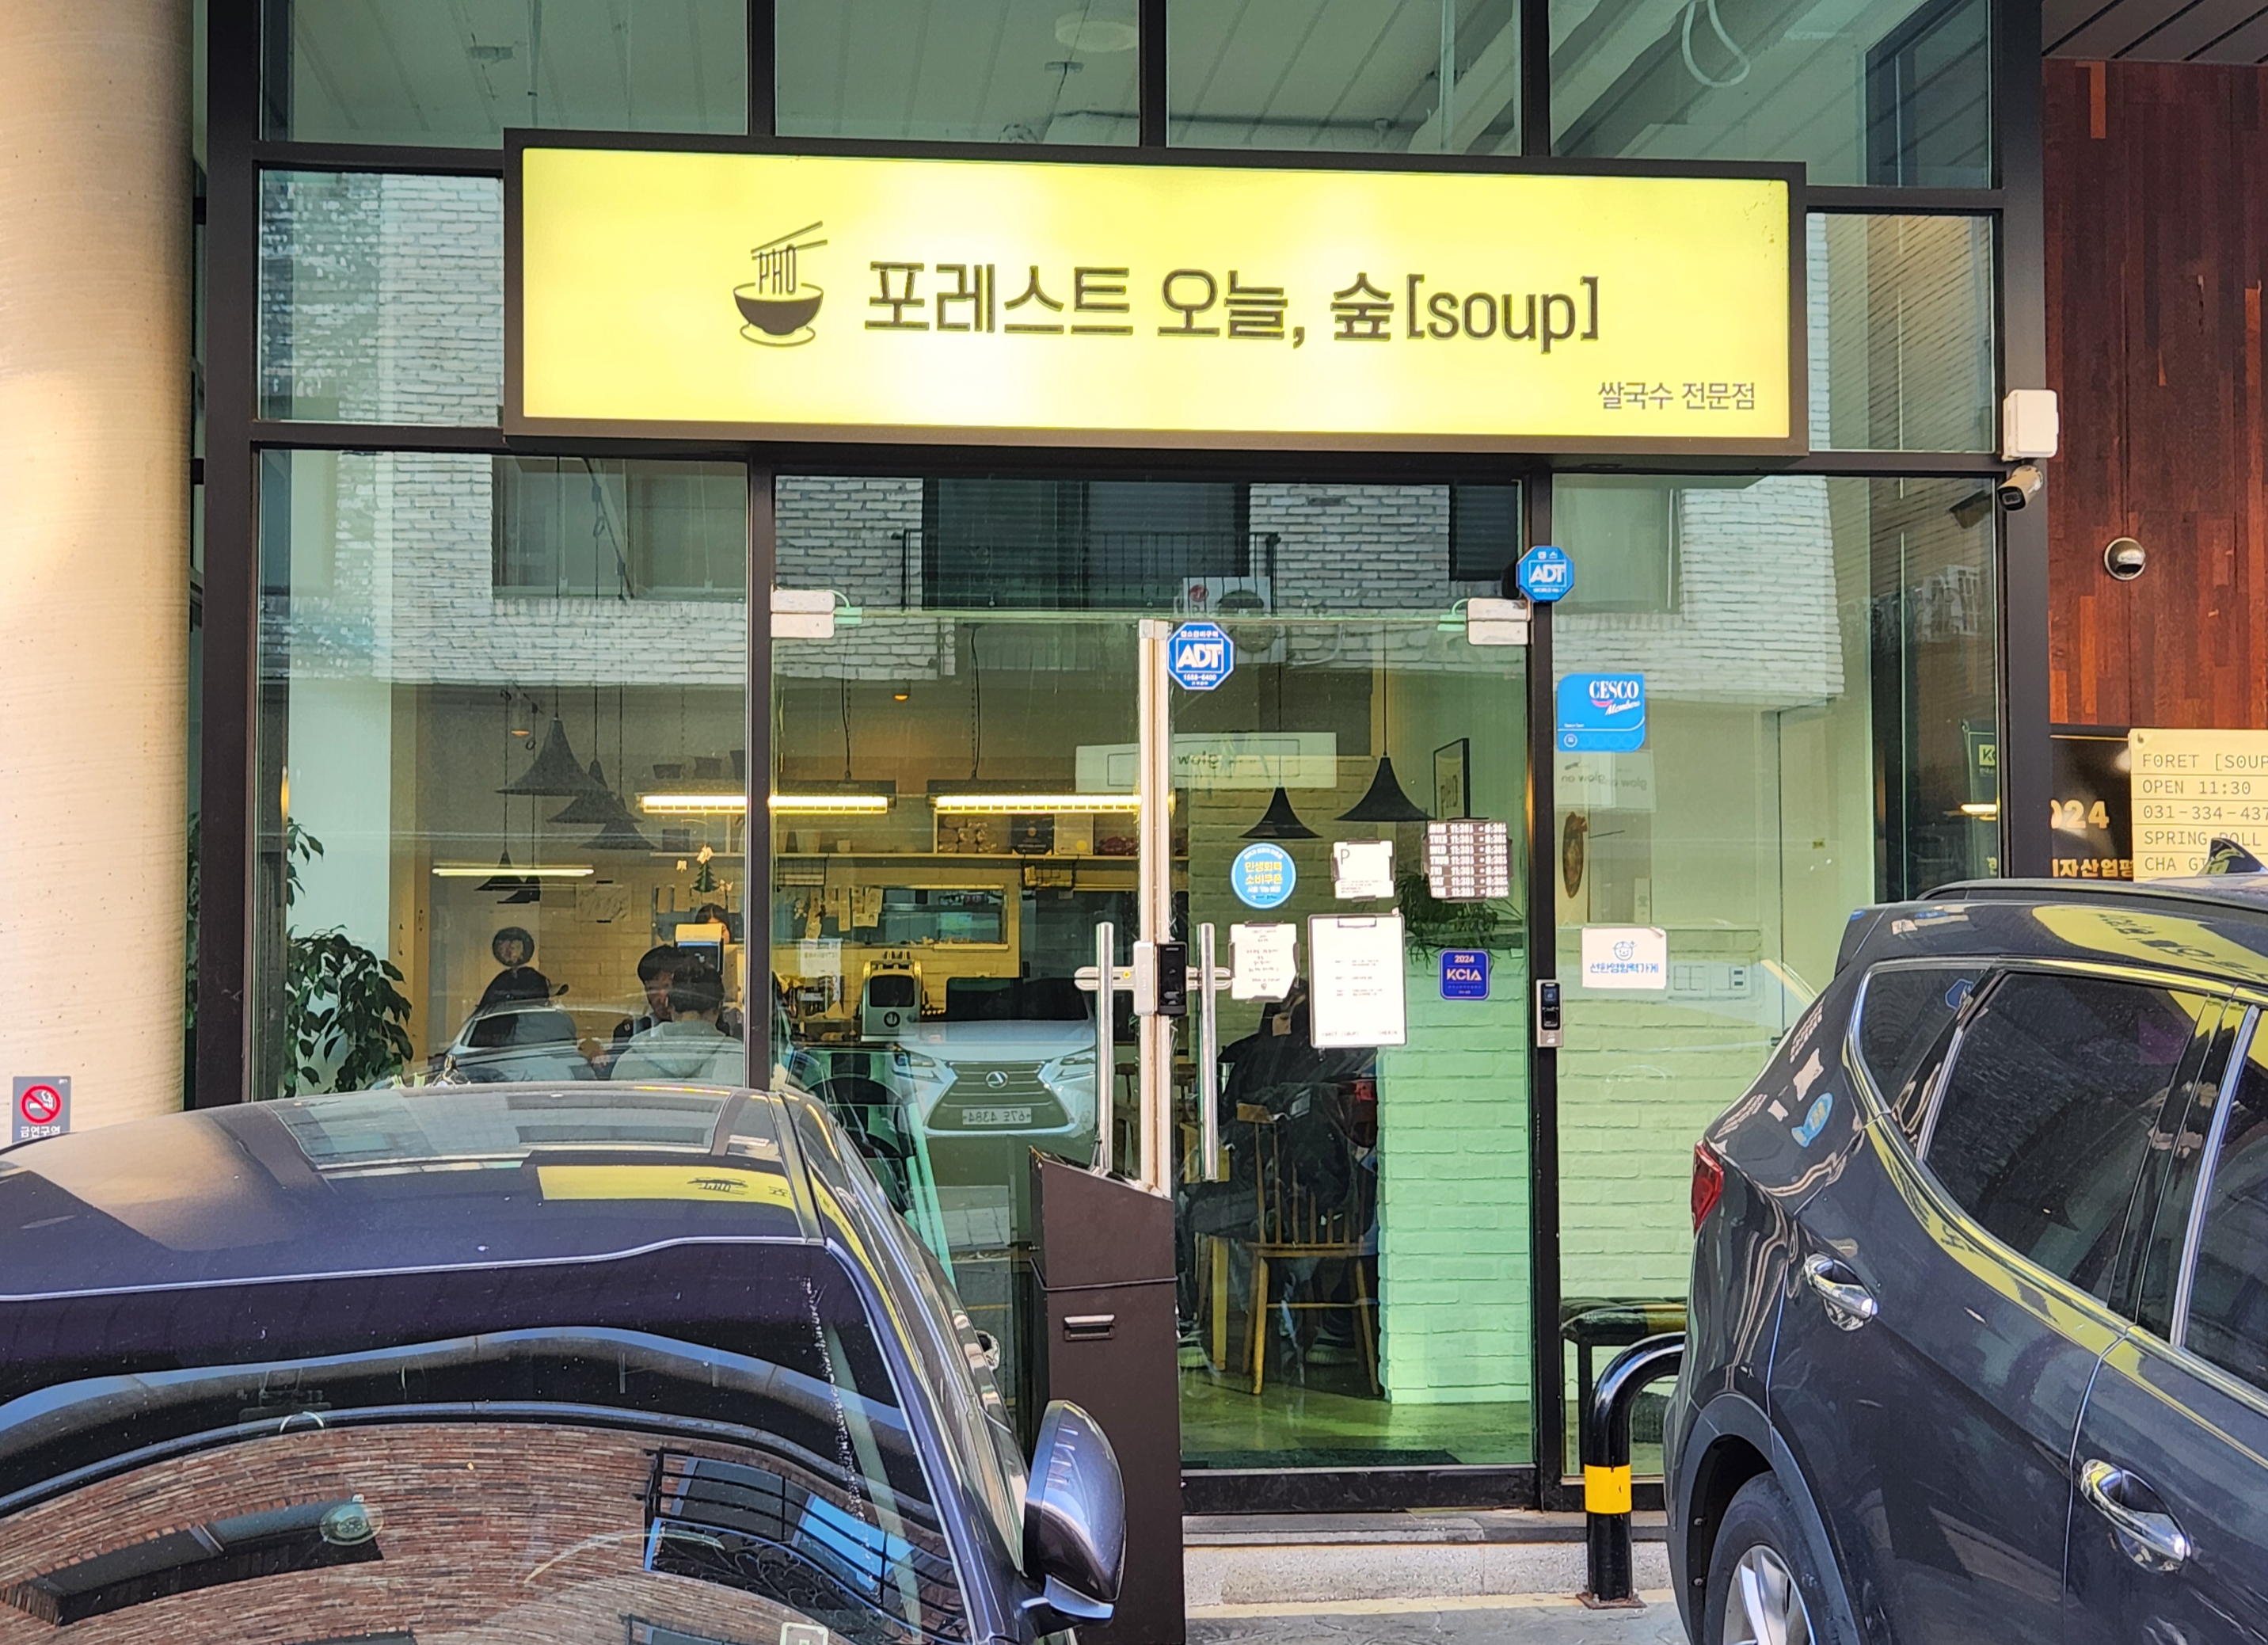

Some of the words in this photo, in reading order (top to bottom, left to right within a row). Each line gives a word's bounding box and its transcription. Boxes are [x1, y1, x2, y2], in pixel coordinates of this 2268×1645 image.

[759, 244, 797, 295] PHO
[865, 261, 1133, 334] 포레스트
[1157, 268, 1305, 349] 오늘,
[1598, 382, 1673, 410] 쌀국수
[1681, 382, 1755, 410] 전문점
[1529, 564, 1565, 583] ADT
[1178, 643, 1223, 668] ADT
[1589, 680, 1639, 699] CESCO
[2143, 753, 2200, 768] FORET
[2143, 779, 2184, 794] OPEN
[2198, 781, 2251, 795] 11:30
[2144, 830, 2208, 846] SPRING
[1341, 848, 1350, 865] P
[2144, 856, 2177, 871] CHA
[1454, 954, 1475, 963] 2024
[1447, 969, 1482, 981] KCIA
[21, 1125, 60, 1138] 금연구역
